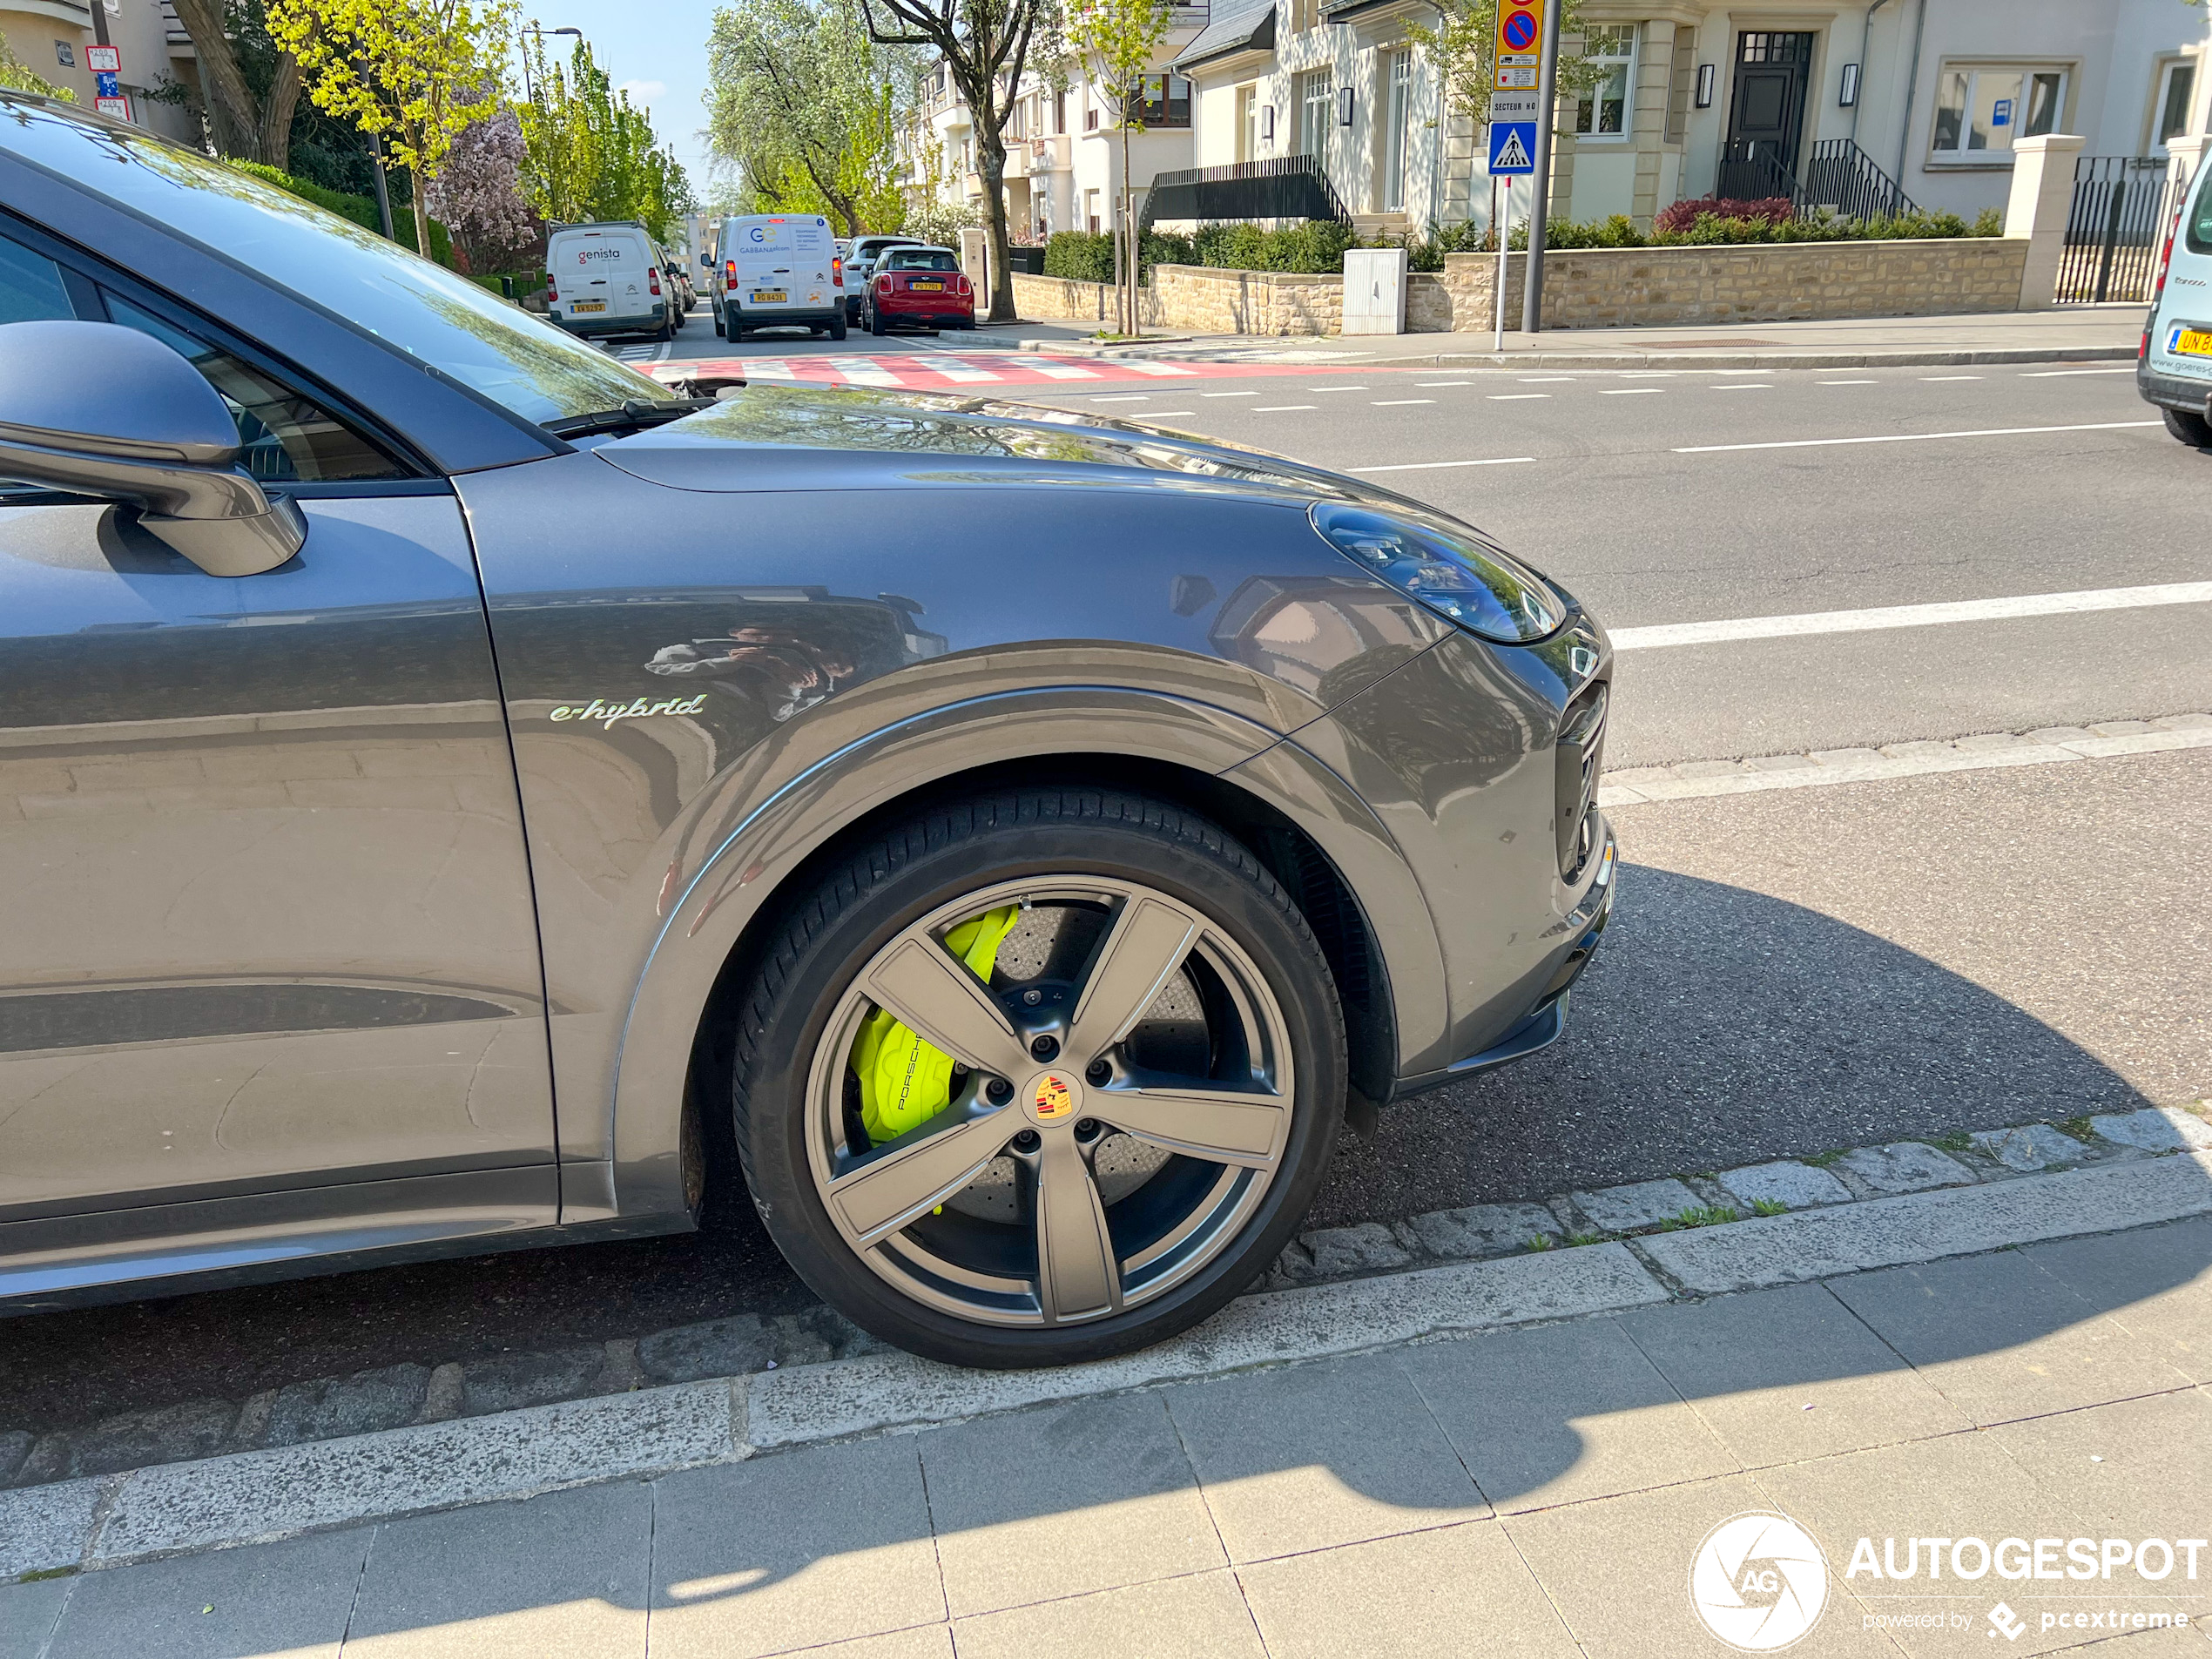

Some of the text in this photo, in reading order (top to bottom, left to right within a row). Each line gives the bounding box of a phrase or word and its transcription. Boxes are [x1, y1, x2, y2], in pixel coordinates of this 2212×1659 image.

[578, 248, 620, 265] genista
[2182, 334, 2202, 350] UN
[550, 693, 708, 730] e-hybrid
